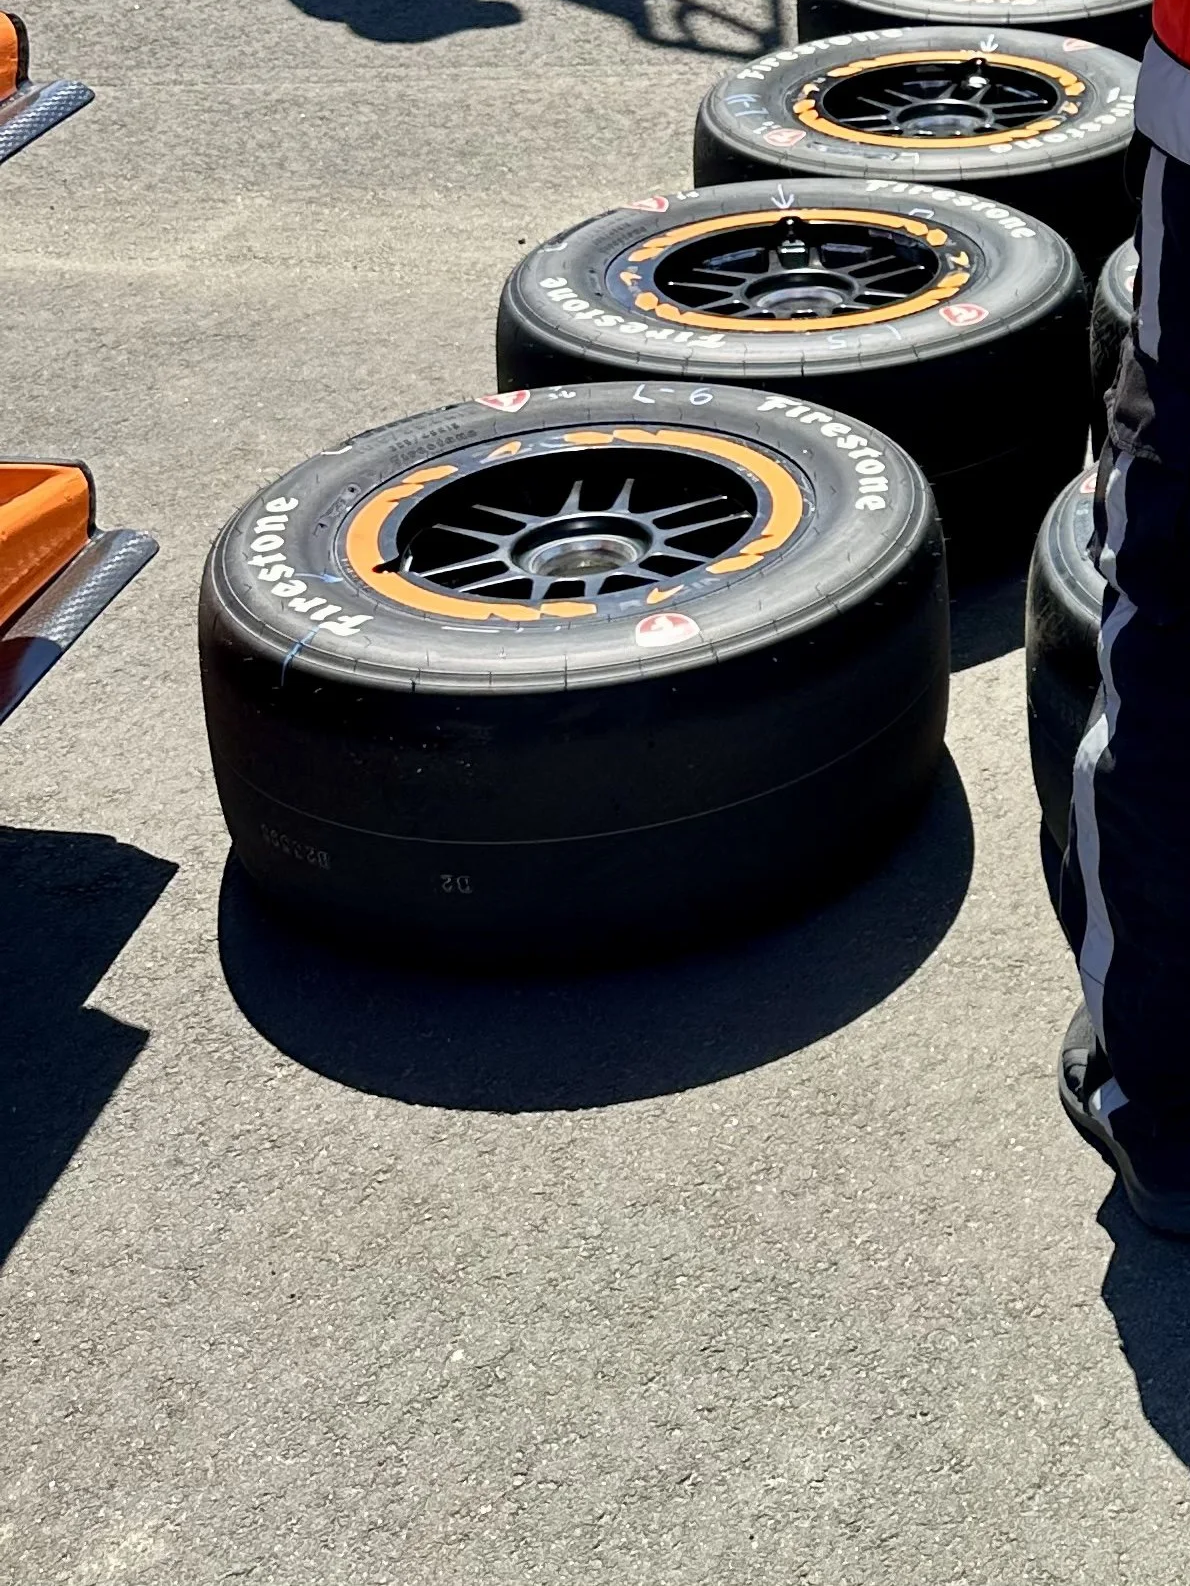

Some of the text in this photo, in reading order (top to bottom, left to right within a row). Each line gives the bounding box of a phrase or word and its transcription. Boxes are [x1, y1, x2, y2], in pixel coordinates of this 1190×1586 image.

[864, 179, 1037, 240] Firestone
[538, 276, 727, 350] Firestone
[756, 395, 890, 512] Firestone
[246, 495, 375, 637] Firestone
